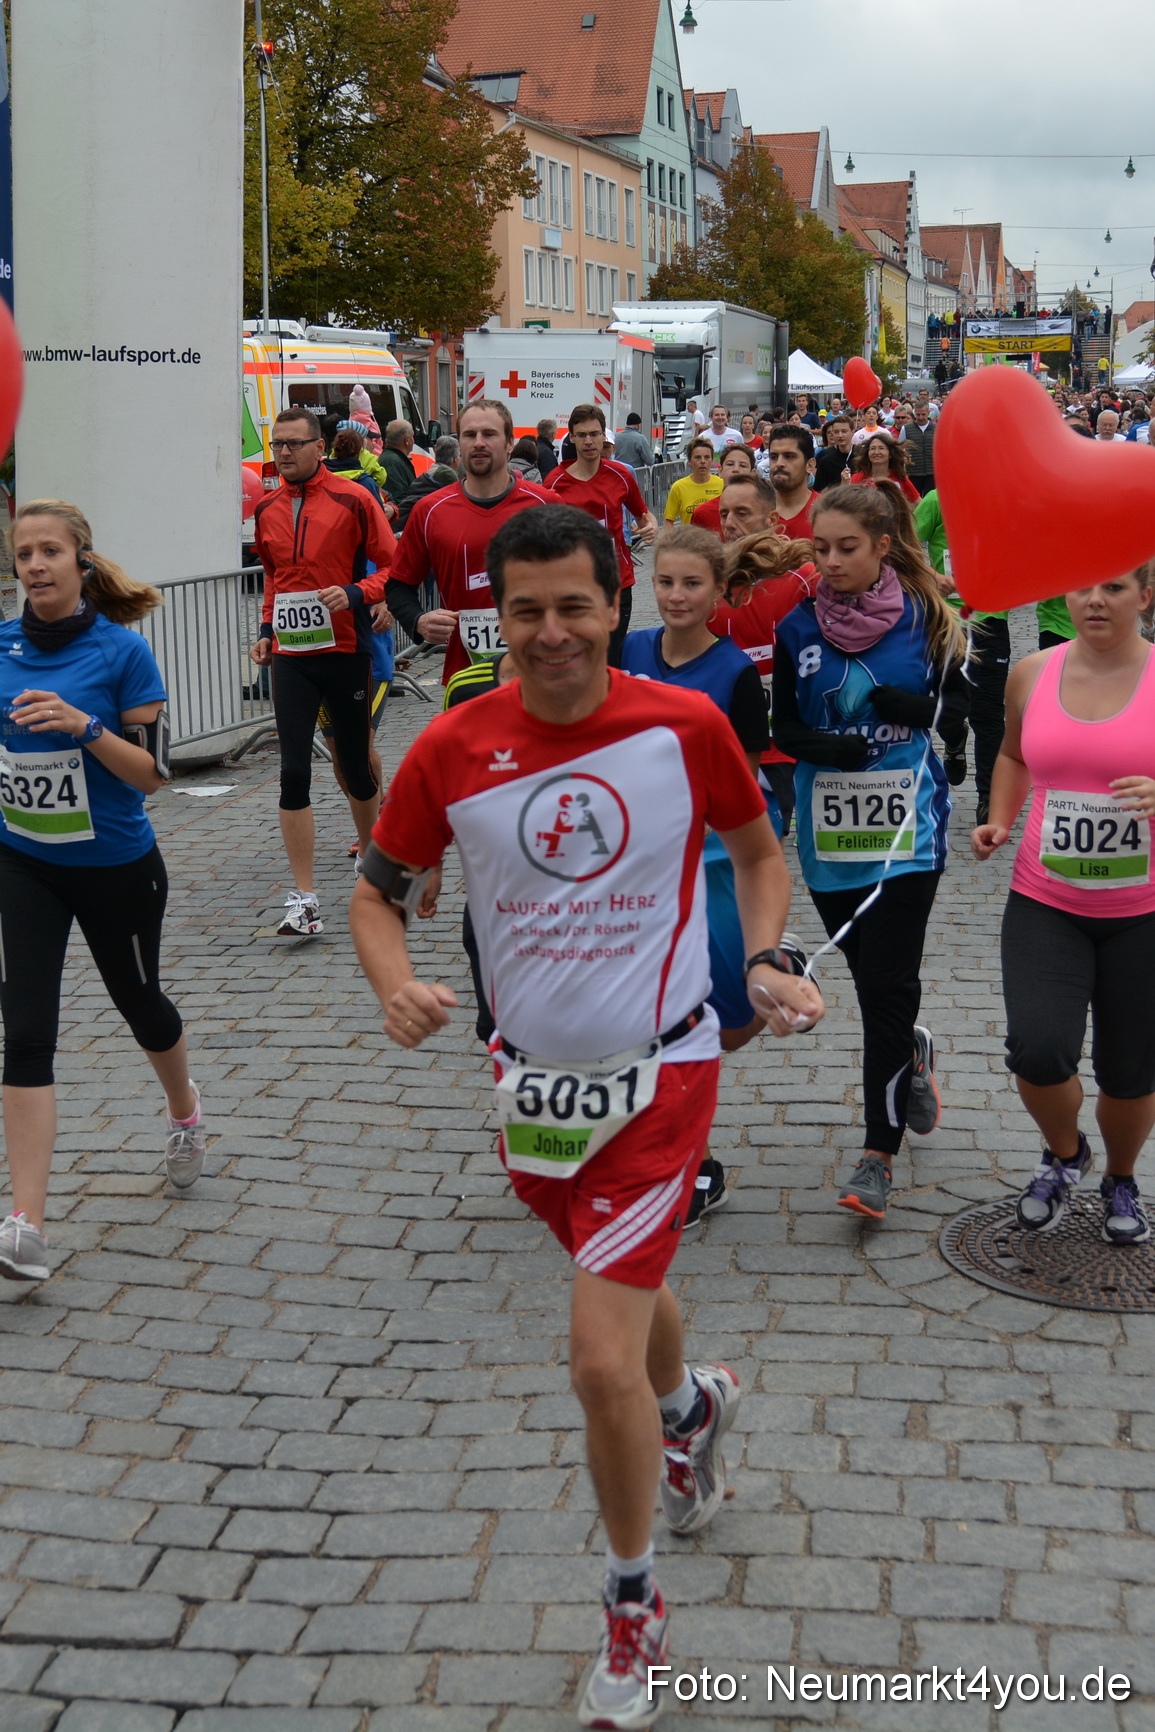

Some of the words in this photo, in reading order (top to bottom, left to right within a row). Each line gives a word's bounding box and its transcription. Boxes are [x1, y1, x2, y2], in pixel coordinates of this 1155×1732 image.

[998, 340, 1036, 350] START
[531, 370, 580, 379] Bayerisches
[531, 381, 554, 389] Rotes
[790, 384, 825, 392] Laufsport
[530, 391, 554, 399] Kreuz
[289, 597, 316, 605] Neumarkt
[277, 605, 325, 630] 5093
[289, 633, 315, 644] Daniel
[467, 625, 509, 650] 512
[798, 644, 822, 678] 8
[15, 761, 65, 772] Neumarkt
[0, 774, 78, 809] 5324
[814, 780, 846, 790] PARTL
[848, 780, 896, 790] Neumarkt
[823, 793, 906, 827] 5126
[1046, 799, 1079, 812] PARTL
[1052, 815, 1142, 853] 5024
[837, 835, 892, 848] Felicitas
[1080, 862, 1109, 876] Lisa
[515, 1066, 639, 1120] 5051
